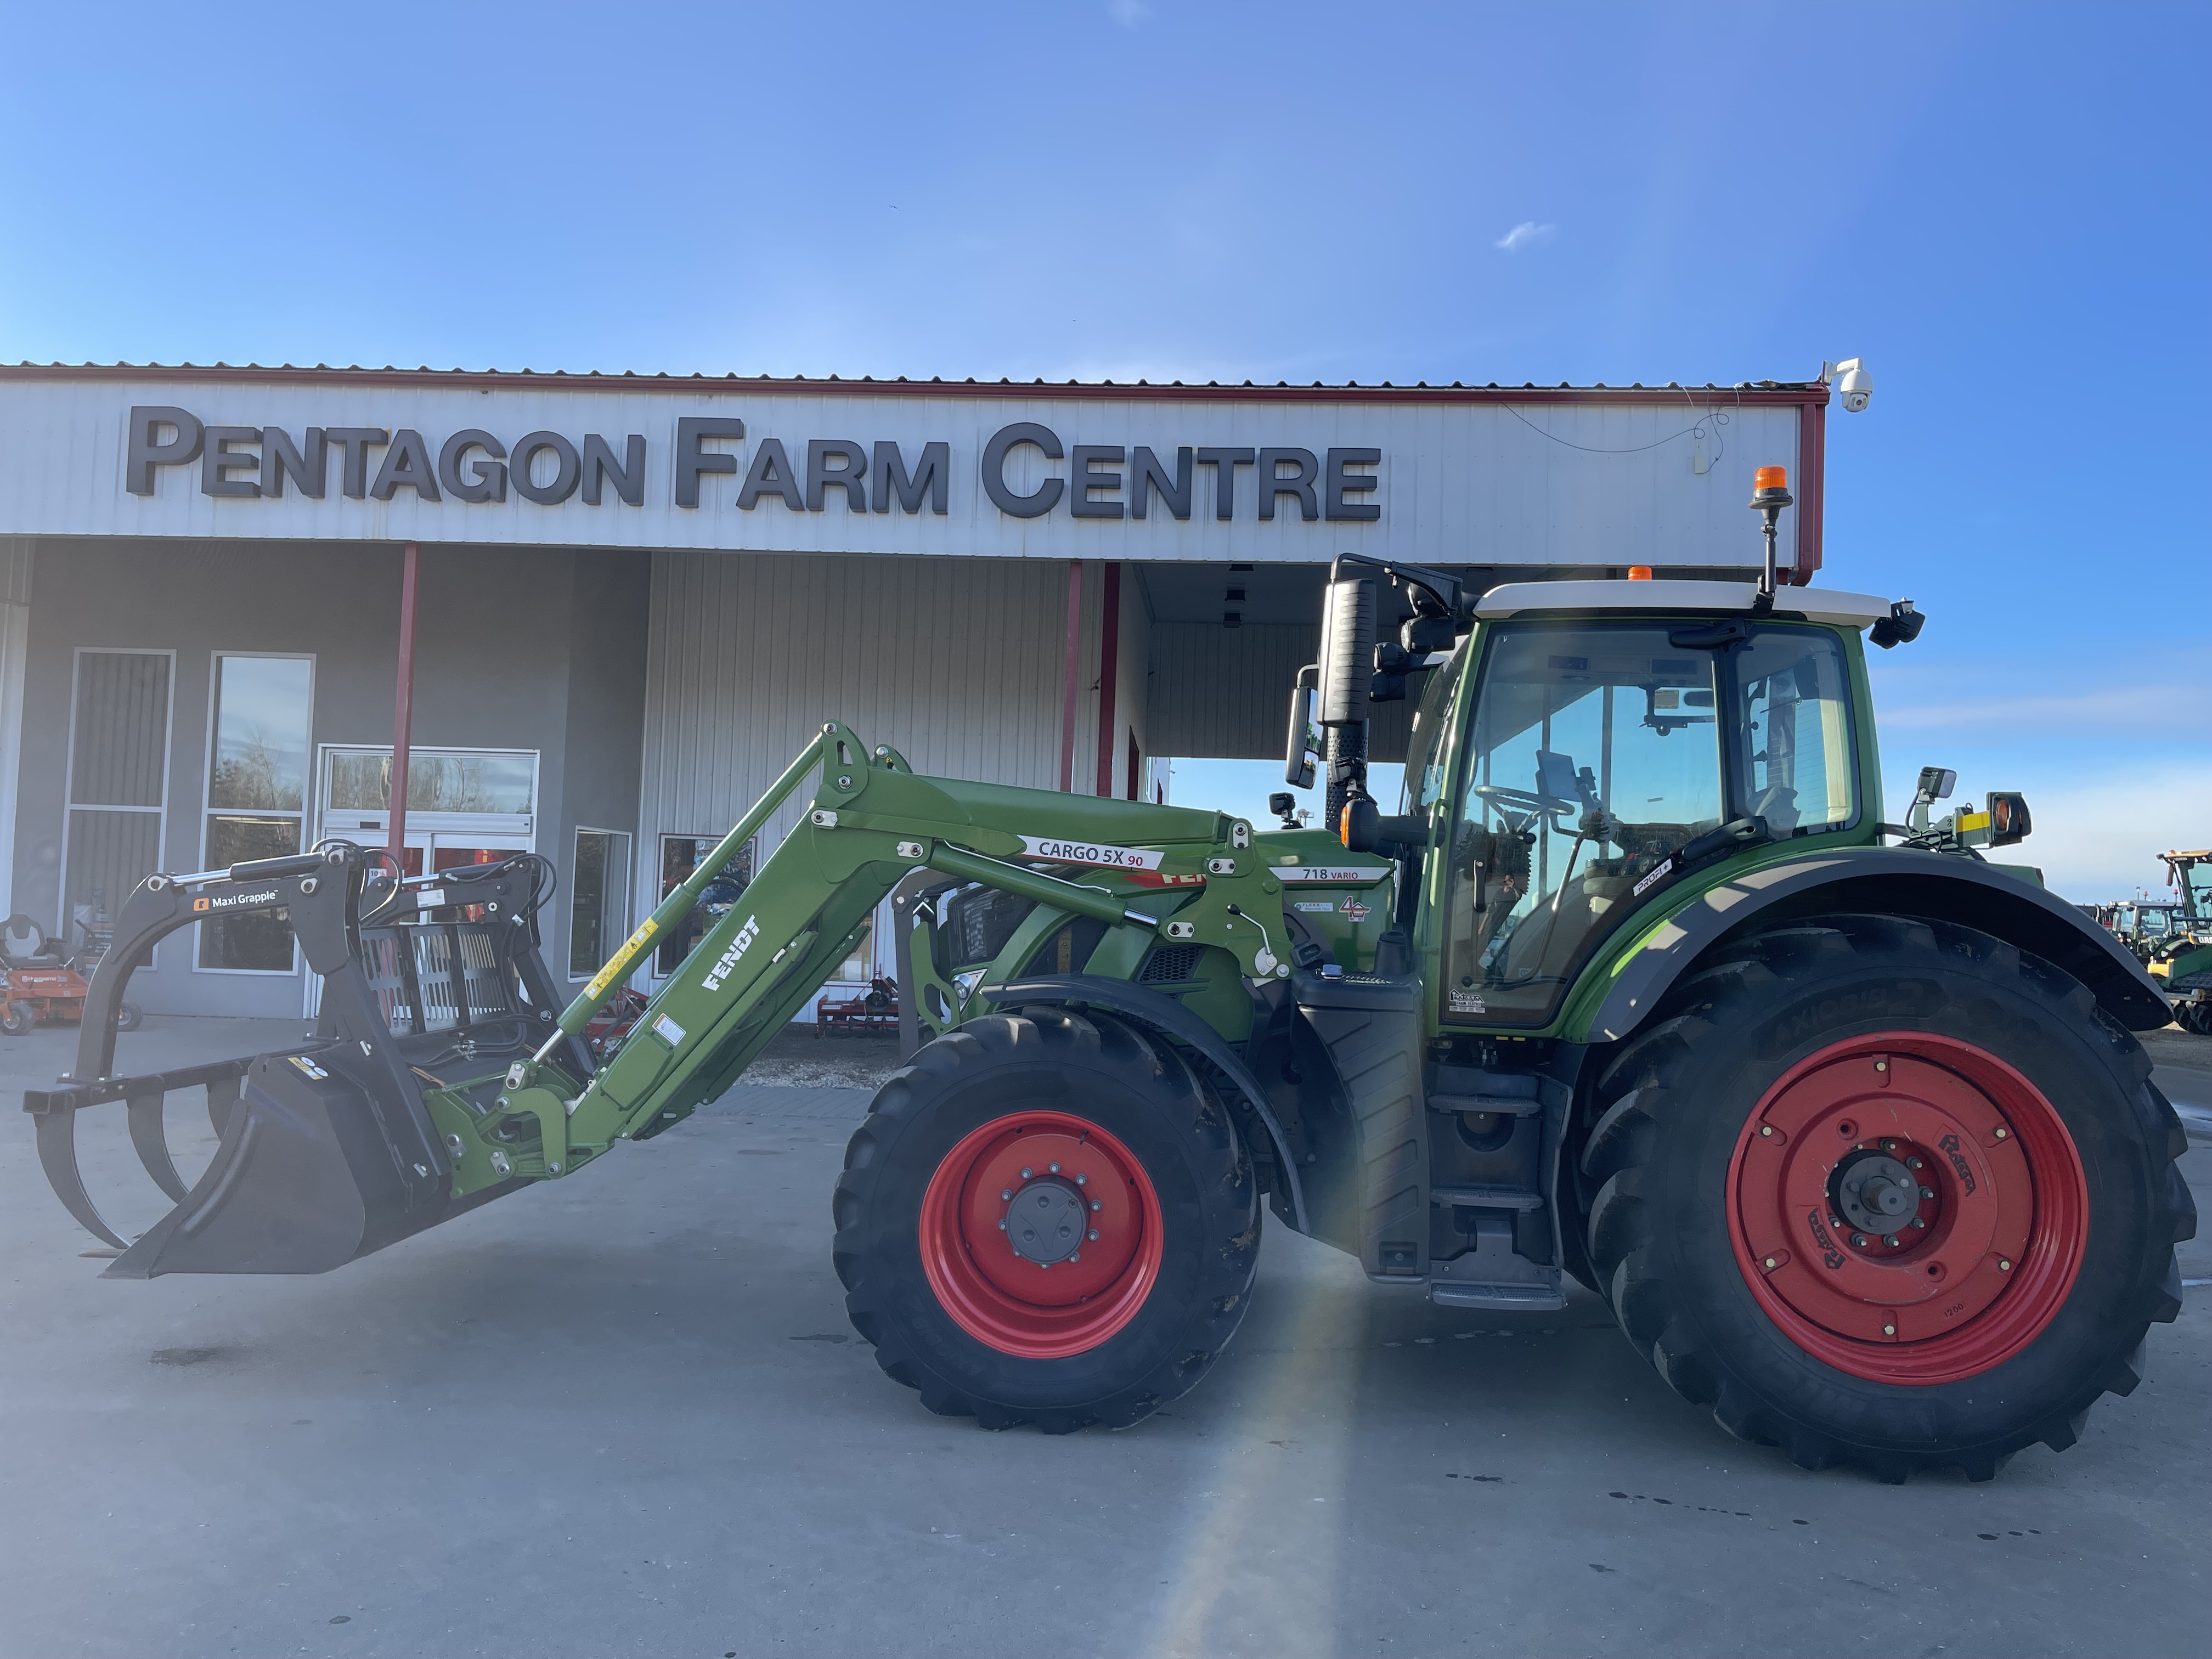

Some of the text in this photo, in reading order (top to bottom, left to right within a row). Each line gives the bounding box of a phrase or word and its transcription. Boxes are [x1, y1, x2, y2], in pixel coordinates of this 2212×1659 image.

[126, 406, 1381, 521] PENTAGON FARM CENTRE
[1039, 842, 1143, 866] CARGO 5X 90
[1303, 869, 1328, 879] 718
[212, 895, 236, 907] Maxi
[702, 914, 760, 991] FENDT
[1943, 1303, 1964, 1318] 1200
